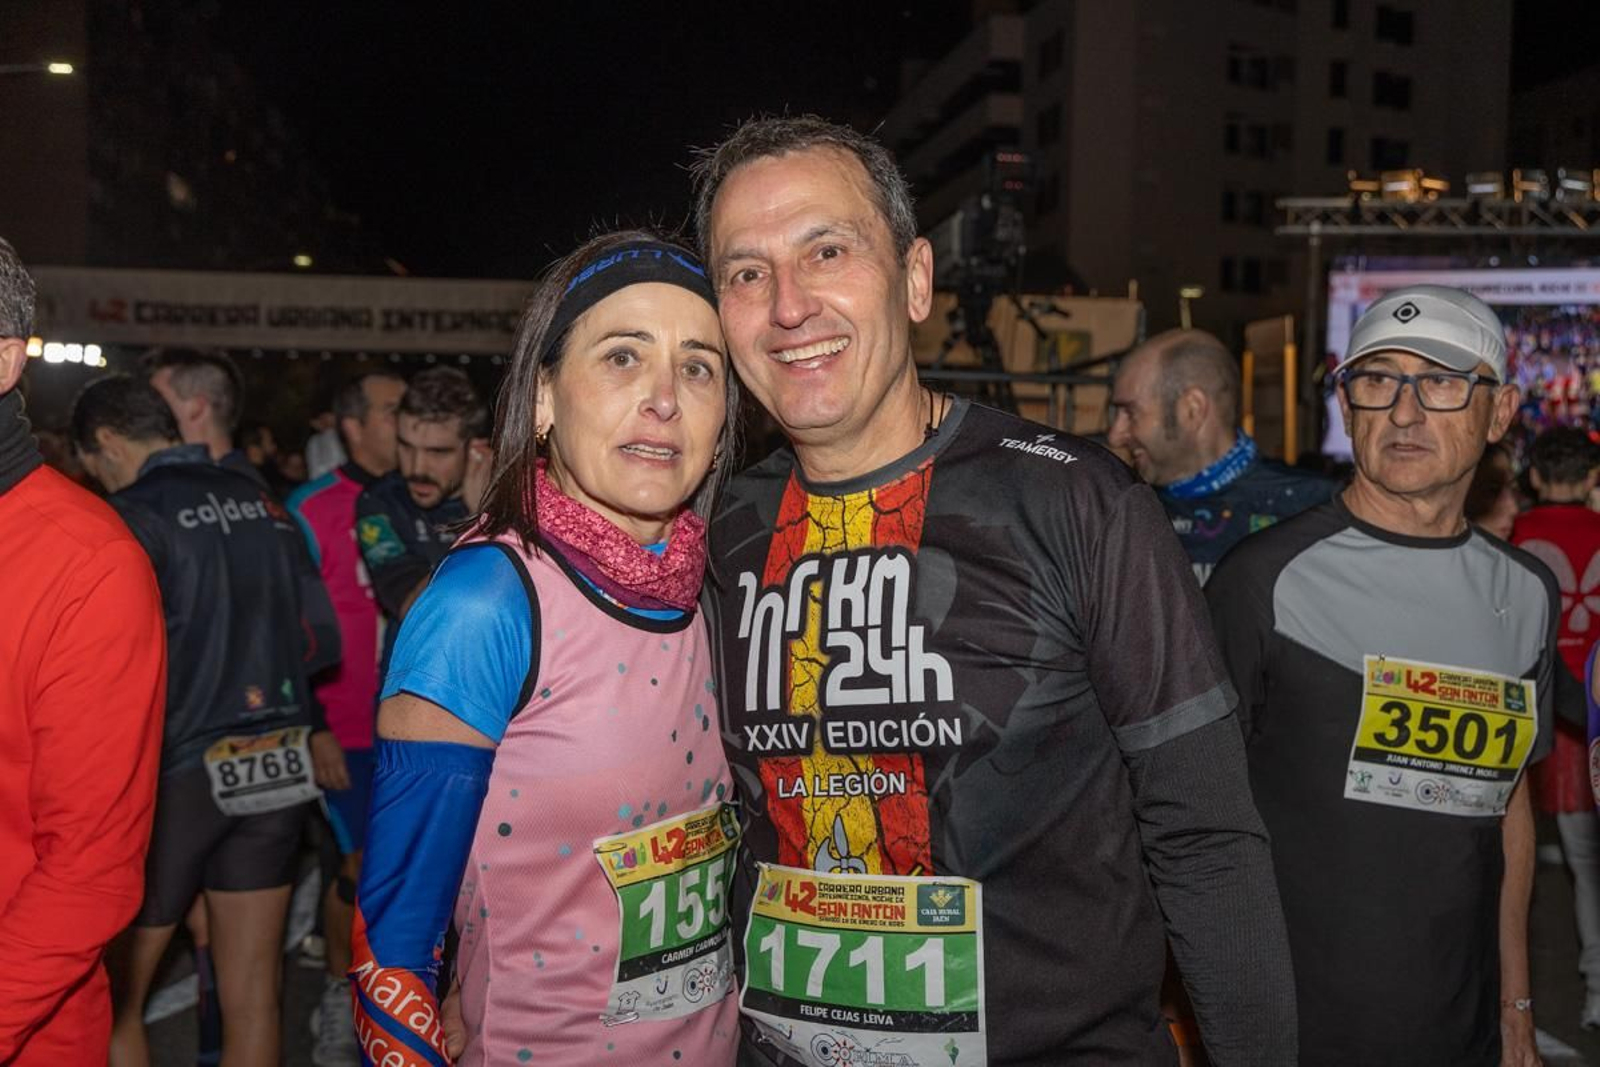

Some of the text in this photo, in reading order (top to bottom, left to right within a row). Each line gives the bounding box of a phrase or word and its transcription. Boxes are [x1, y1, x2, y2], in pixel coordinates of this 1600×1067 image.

[999, 438, 1078, 464] TEAMERGY
[1405, 669, 1438, 696] 42
[744, 712, 963, 751] XXIV EDICIÓN
[1373, 700, 1518, 764] 3501
[218, 749, 303, 788] 8768
[1410, 758, 1444, 770] ANTONIO
[777, 769, 906, 798] LA LEGIÓN
[650, 827, 688, 865] 42
[784, 879, 818, 916] 42
[818, 882, 905, 896] CARRERA URBANA
[817, 902, 906, 920] SAN ANTON
[759, 923, 945, 1007] 1711
[800, 1004, 894, 1026] FELIPE CEJAS LEIVA
